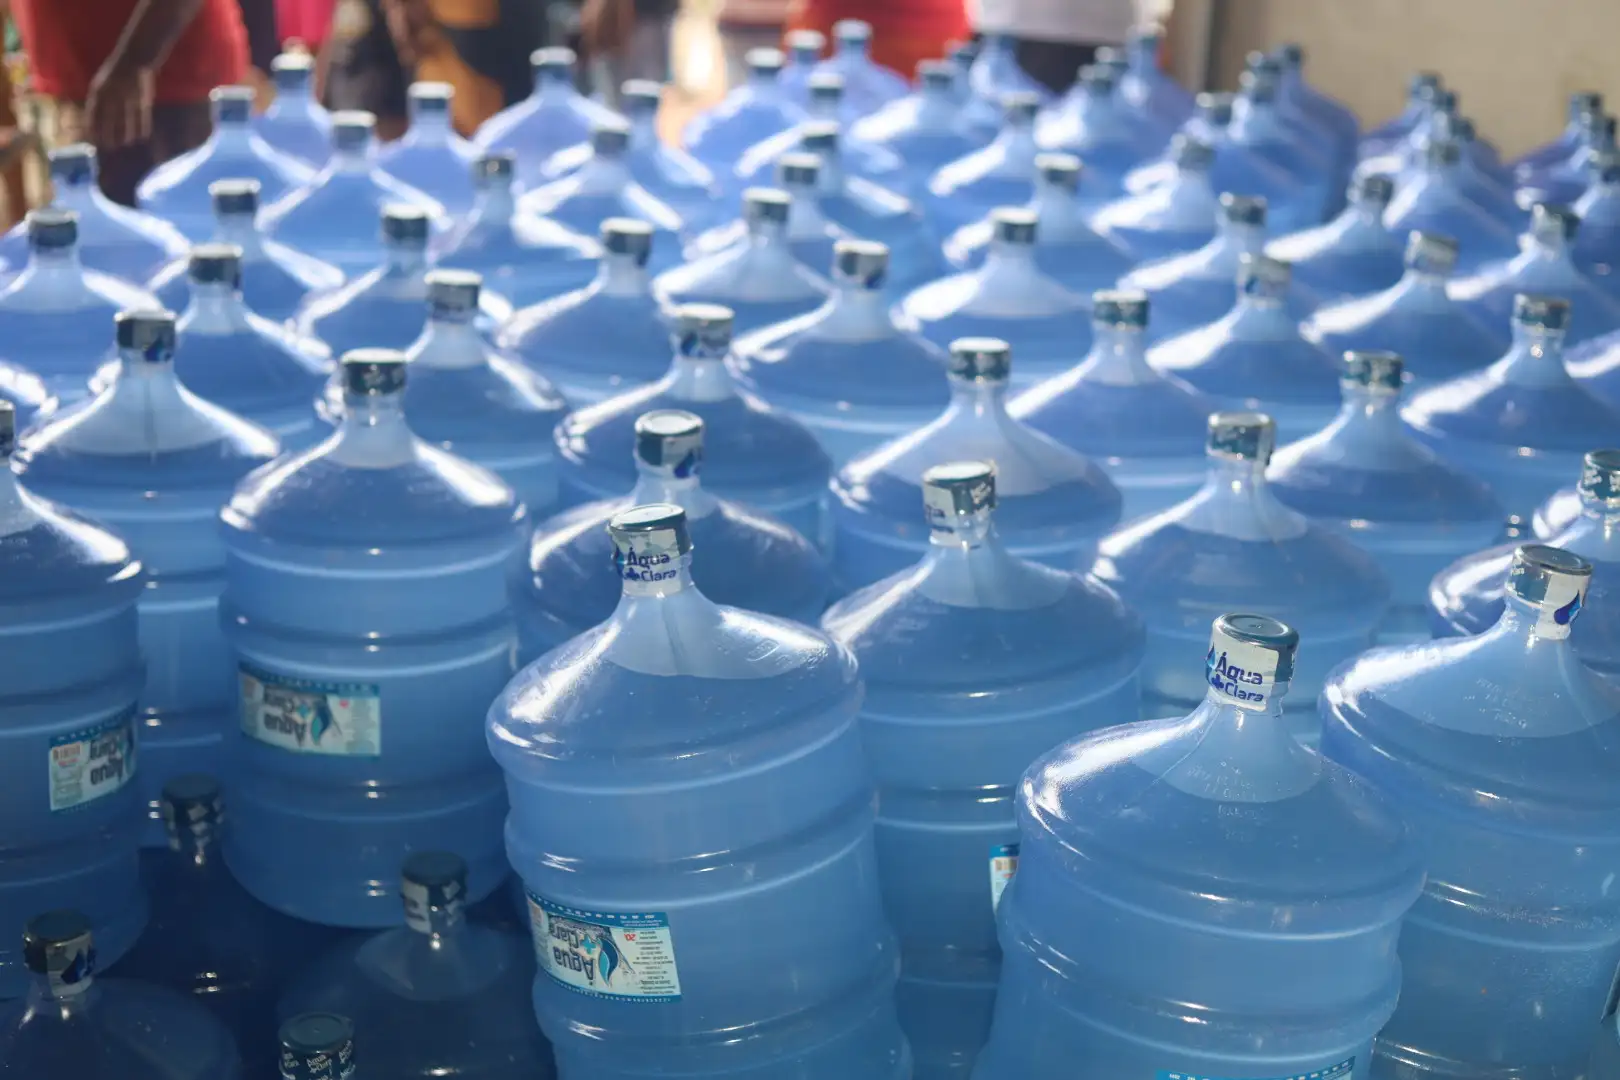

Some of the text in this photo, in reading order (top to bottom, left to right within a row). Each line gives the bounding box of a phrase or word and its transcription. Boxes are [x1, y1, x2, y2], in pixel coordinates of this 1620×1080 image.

[627, 546, 670, 569] Água
[1215, 651, 1263, 685] Água
[1225, 682, 1265, 702] Clara
[553, 946, 594, 986] Água
